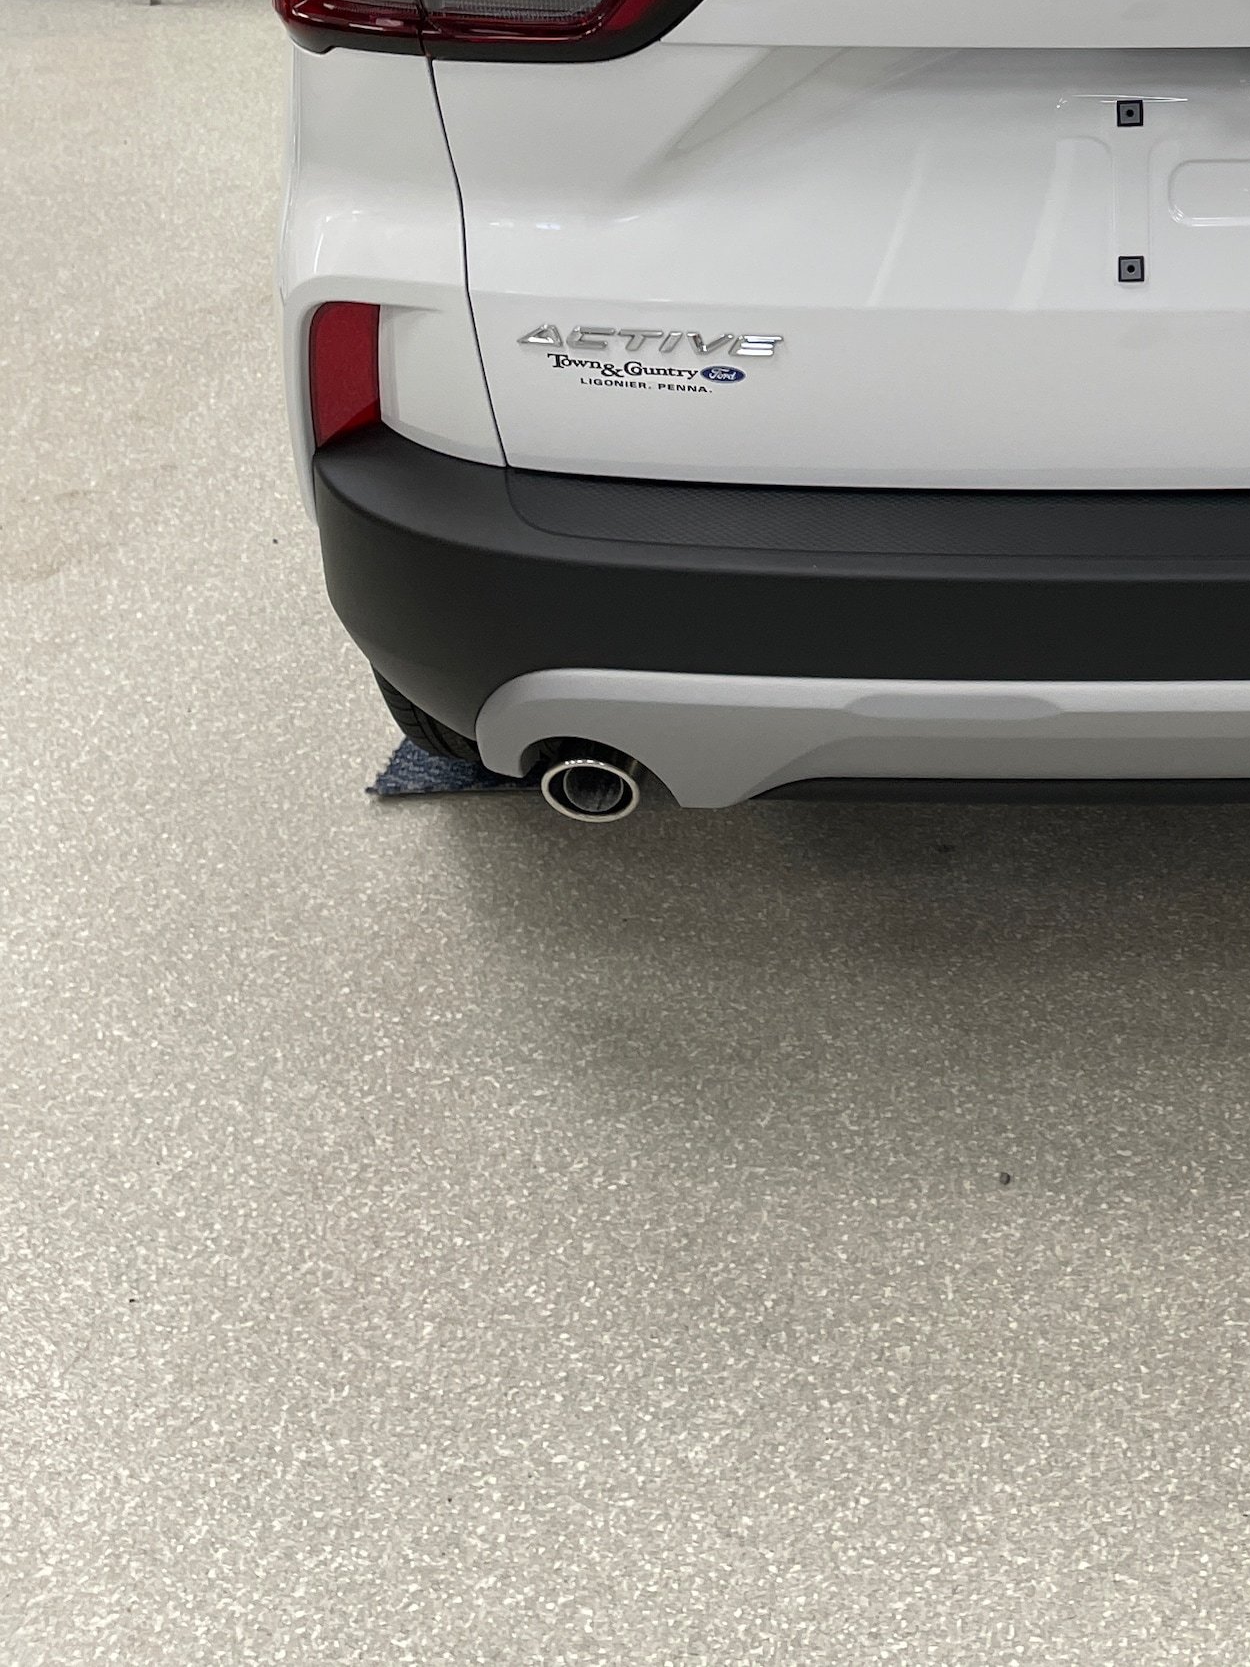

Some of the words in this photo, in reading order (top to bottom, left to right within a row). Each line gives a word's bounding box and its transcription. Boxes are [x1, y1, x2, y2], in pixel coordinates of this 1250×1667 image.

[516, 323, 784, 356] ACTIVE
[709, 368, 737, 381] Ford
[658, 384, 712, 393] PENNA.
